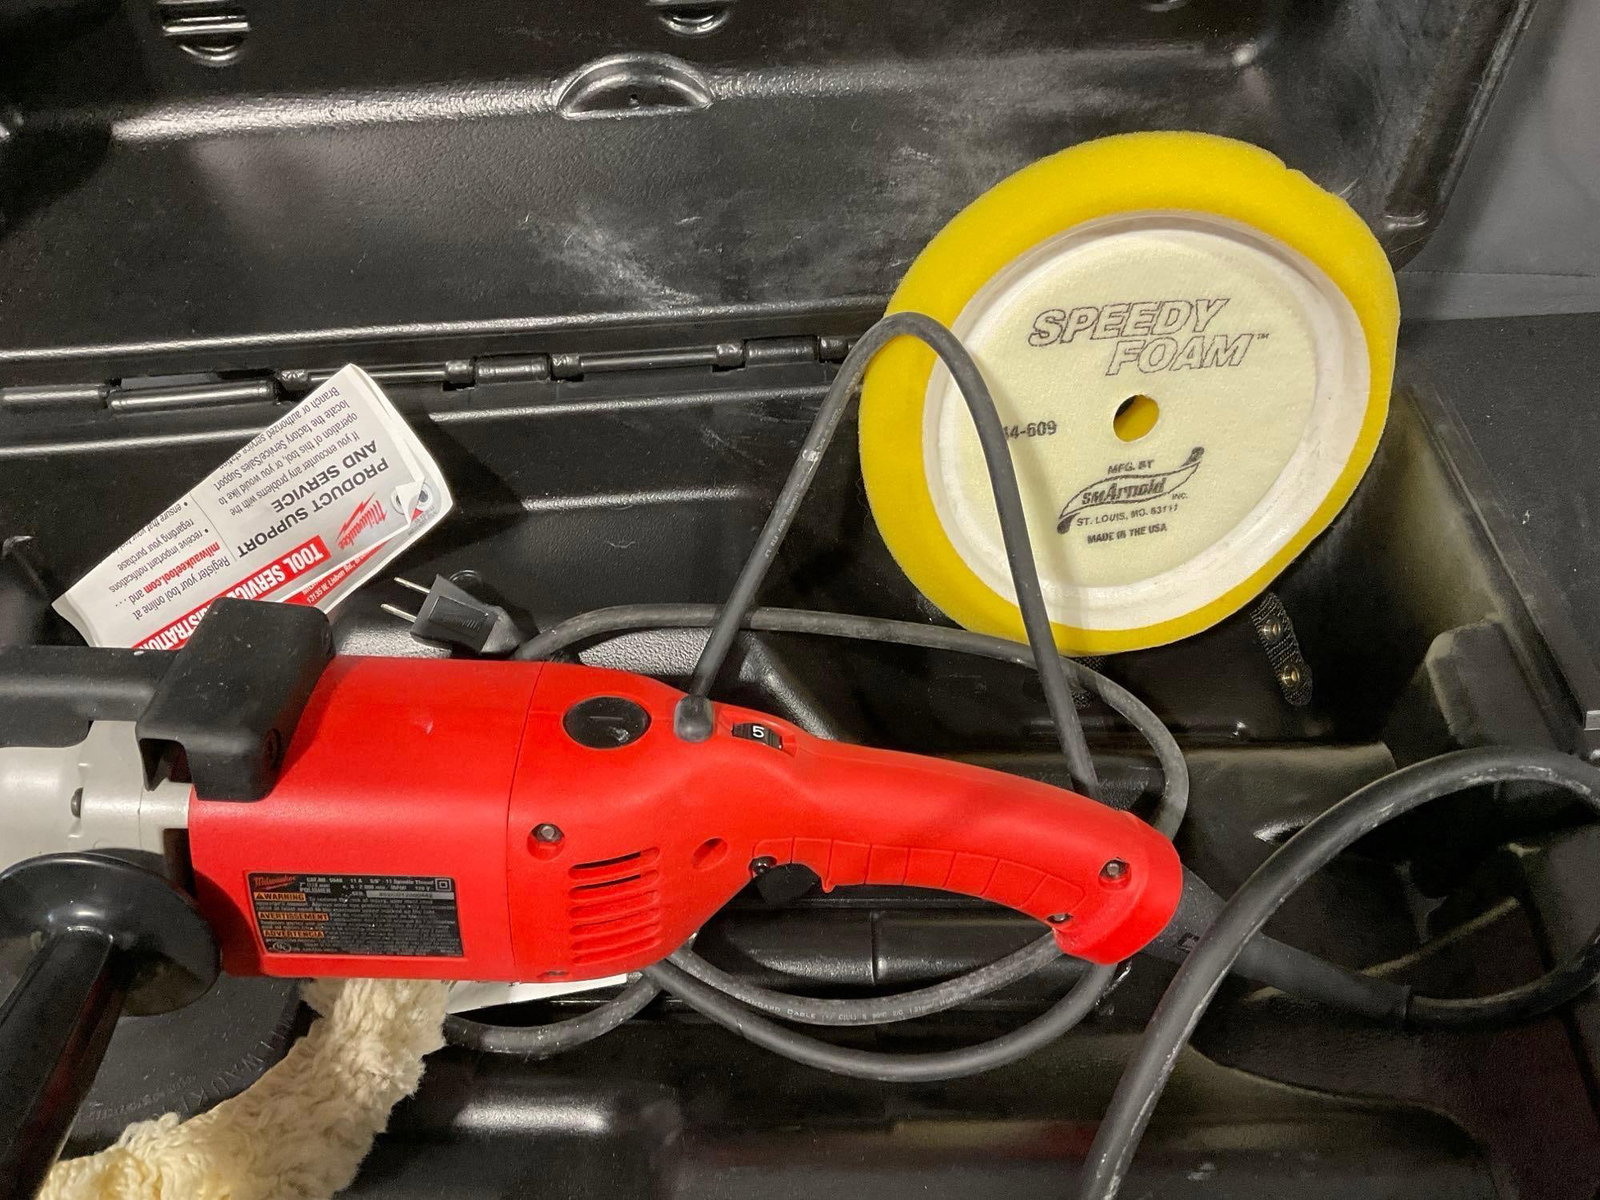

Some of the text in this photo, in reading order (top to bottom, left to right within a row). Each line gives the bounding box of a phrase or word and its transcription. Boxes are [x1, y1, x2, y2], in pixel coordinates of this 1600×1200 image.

[1028, 298, 1230, 347] SPEEDY
[310, 386, 340, 409] Branch
[300, 404, 310, 414] or
[264, 410, 302, 440] authorized
[320, 410, 358, 440] operation
[212, 398, 350, 491] locate the factory Service/Sales Support
[298, 440, 314, 454] this
[313, 434, 324, 446] of
[228, 430, 360, 516] If you encounter any problems with the
[259, 463, 275, 478] you
[274, 459, 284, 469] or
[1107, 460, 1155, 474] MFG. BY
[238, 474, 262, 493] would
[270, 440, 378, 513] AND SERVICE
[218, 496, 228, 506] to
[226, 488, 242, 500] like
[1171, 492, 1188, 500] INC.
[235, 456, 388, 558] PRODUCT SUPPORT
[160, 517, 194, 543] regarding
[338, 500, 387, 549] Milwaukee
[1076, 517, 1092, 527] ST.
[178, 530, 202, 549] receive
[1087, 523, 1168, 544] MADE IN THE USA
[146, 536, 162, 552] your
[116, 546, 148, 571] purchase
[146, 544, 179, 570] important
[282, 542, 324, 574] TOOL
[142, 542, 220, 594] milwaukeetool.com
[108, 564, 148, 593] notifications
[132, 554, 230, 620] Register your tool online at
[328, 570, 346, 587] Lisbon
[128, 588, 144, 604] and
[752, 725, 765, 738] 5
[264, 893, 305, 901] WARNING
[260, 912, 328, 920] AVERTISSEMENT
